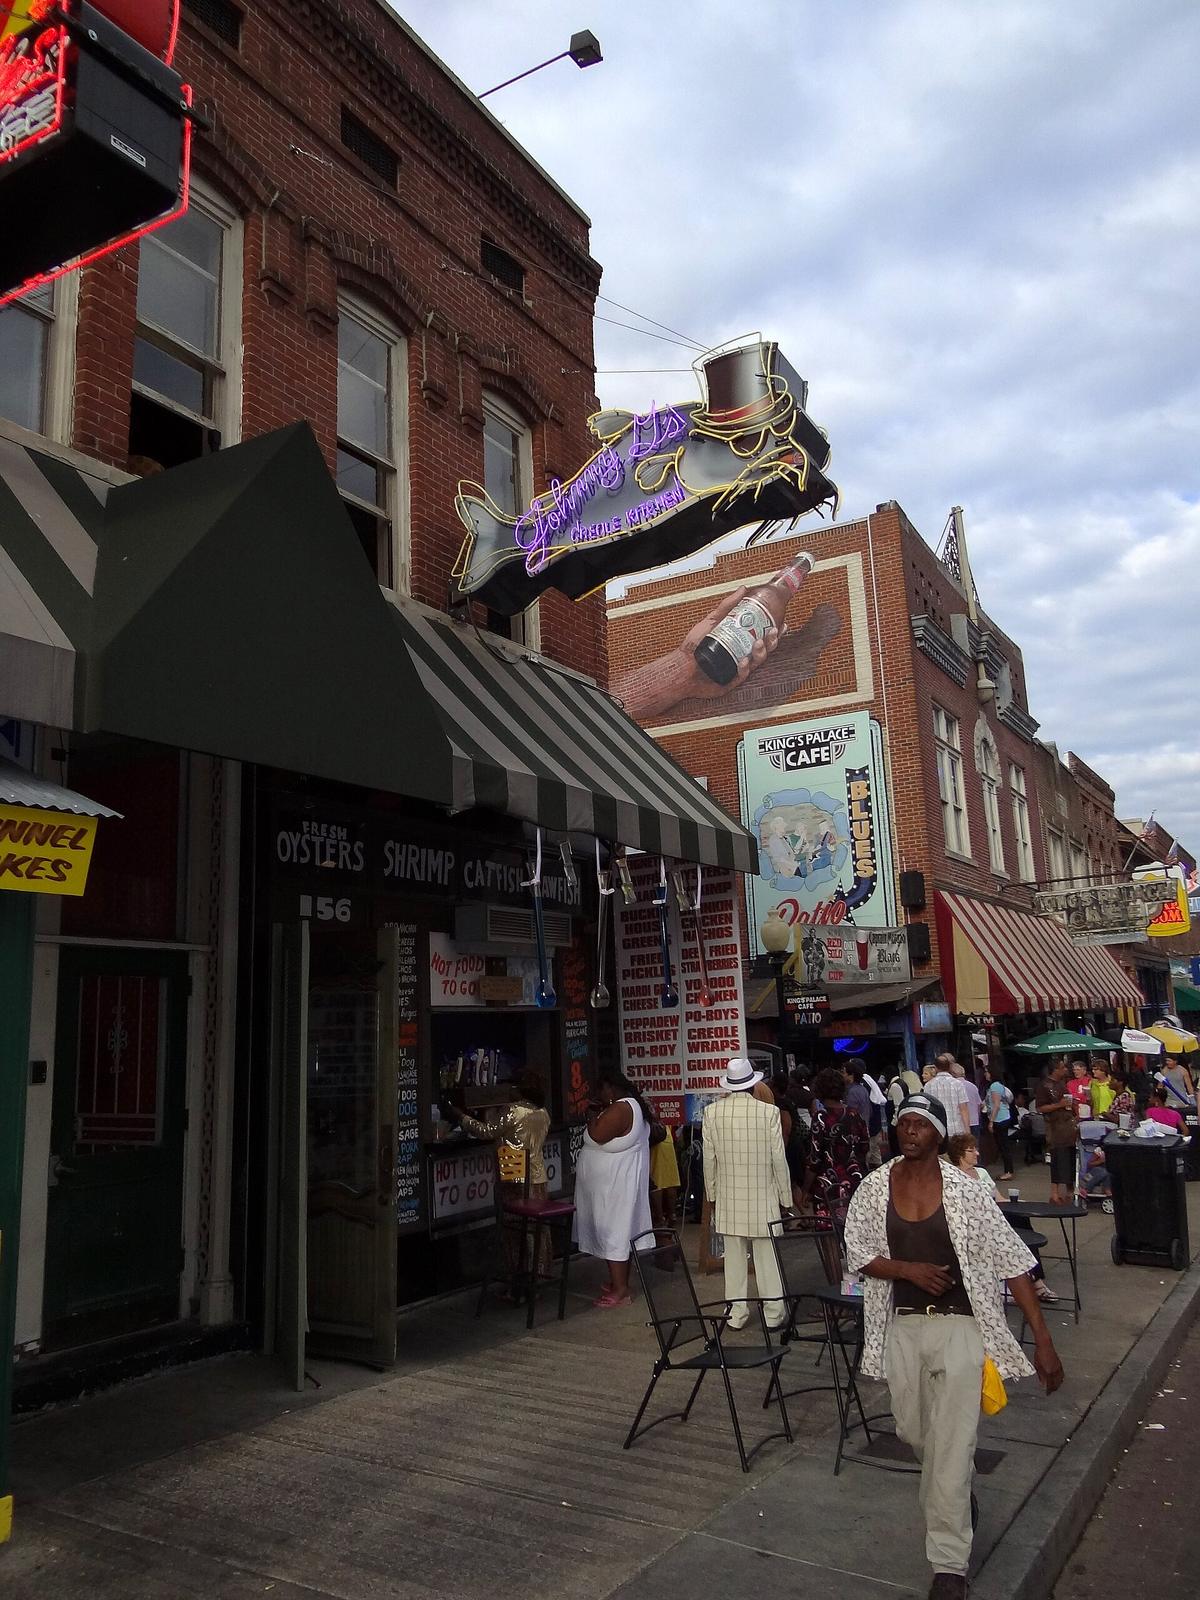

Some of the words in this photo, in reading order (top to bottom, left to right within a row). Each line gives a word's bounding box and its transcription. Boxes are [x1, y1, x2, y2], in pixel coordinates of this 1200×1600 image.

[765, 737, 804, 752] KING'S
[805, 728, 848, 745] PALACE
[786, 746, 830, 767] CAFE
[0, 819, 88, 850] NNEL
[302, 821, 347, 840] FRESH
[850, 780, 874, 878] BLUES
[0, 852, 73, 881] KES
[277, 831, 364, 871] OYSTERS
[384, 840, 455, 885] SHRIMP
[464, 860, 524, 893] CATFISH
[528, 874, 581, 905] AWFISH
[300, 894, 352, 922] 156
[681, 912, 733, 929] CHCKEN
[624, 924, 661, 935] HOUS
[681, 947, 701, 960] DEE
[709, 943, 738, 957] FRIED
[431, 952, 453, 977] HOT
[454, 955, 484, 978] FOOD
[622, 964, 677, 980] PICKLS
[681, 957, 738, 974] STRABERRIES
[442, 980, 457, 995] TO
[685, 975, 735, 990] VODOO
[621, 984, 652, 998] MARDI
[685, 989, 738, 1004] CHKEN
[623, 998, 659, 1011] CHEESE
[685, 1007, 739, 1022] PO-BOYS
[794, 1011, 822, 1024] PATIO
[967, 1017, 995, 1025] ATM
[623, 1015, 680, 1031] PEPPADEW
[624, 1028, 679, 1043] BRISKET
[687, 1025, 739, 1040] CREOLE
[627, 1043, 677, 1058] PO-BOY
[687, 1039, 740, 1053] WRAPS
[626, 1063, 681, 1077] STUFFED
[687, 1058, 730, 1071] GUMB
[685, 1076, 722, 1089] JAMBA
[401, 1089, 417, 1101] DOG
[399, 1102, 418, 1116] DOG
[398, 1128, 419, 1141] SAGE
[543, 1143, 560, 1160] EER
[436, 1160, 458, 1182] HOT
[462, 1152, 493, 1177] FOOD
[439, 1185, 460, 1206] TO
[466, 1180, 489, 1201] GO
